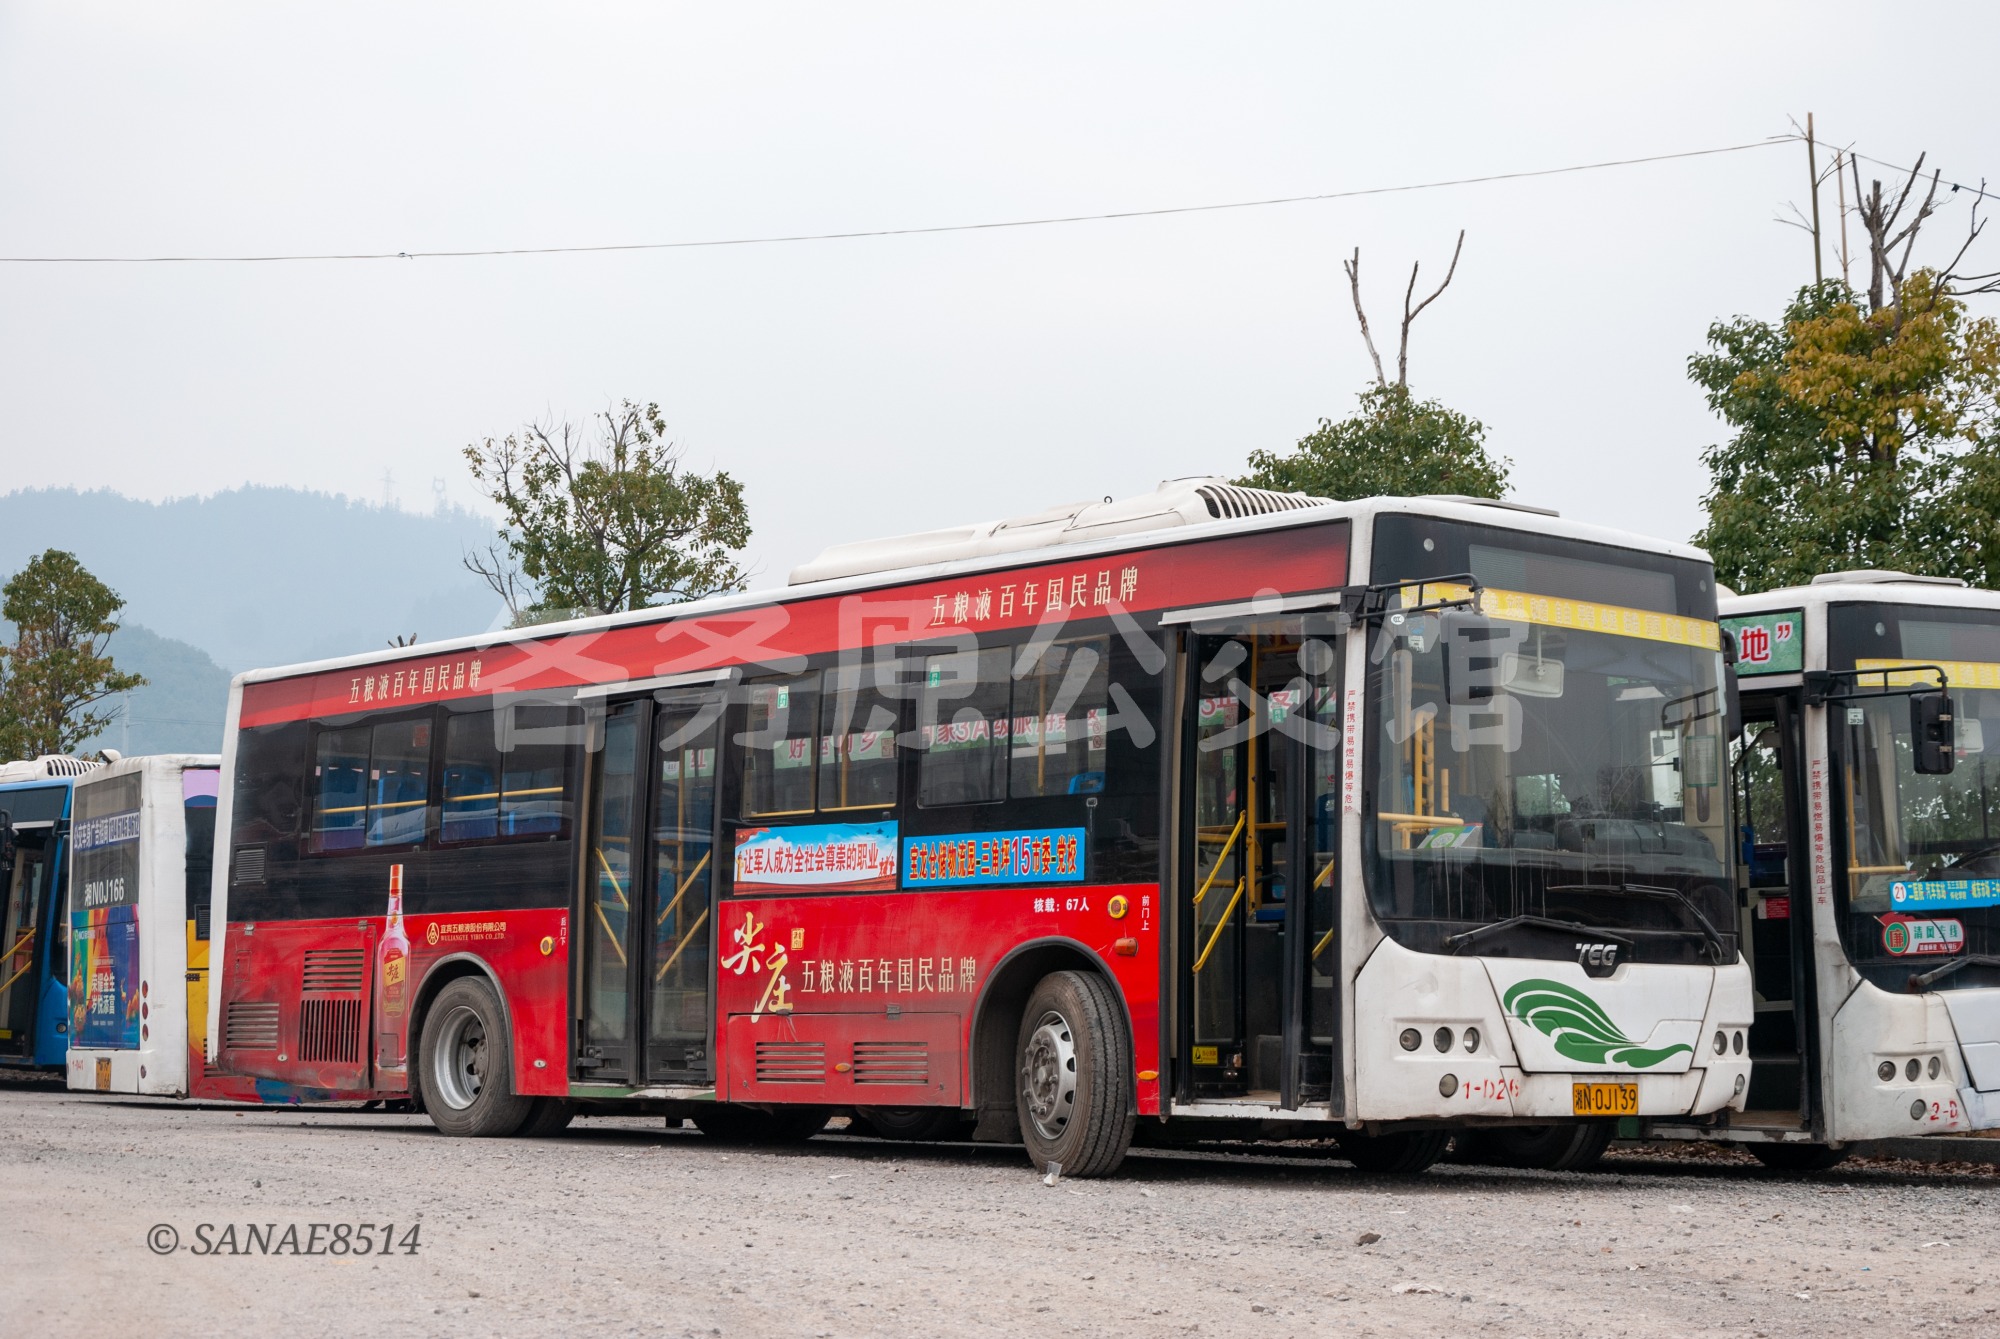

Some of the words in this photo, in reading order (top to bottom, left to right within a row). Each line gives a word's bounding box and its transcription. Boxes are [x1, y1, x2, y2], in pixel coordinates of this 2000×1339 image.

[930, 566, 1138, 626] 五粮液百年国民品牌
[348, 659, 482, 704] 五粮液百年国民品牌
[1812, 759, 1827, 905] 严禁携带易燃易爆等危险品上车
[743, 843, 879, 874] 让军人成为全社会尊崇的职业
[1895, 886, 1905, 899] 21
[1141, 895, 1150, 931] 前门上
[1575, 943, 1618, 966] TEG
[801, 957, 977, 993] 五粮液百年国民品牌
